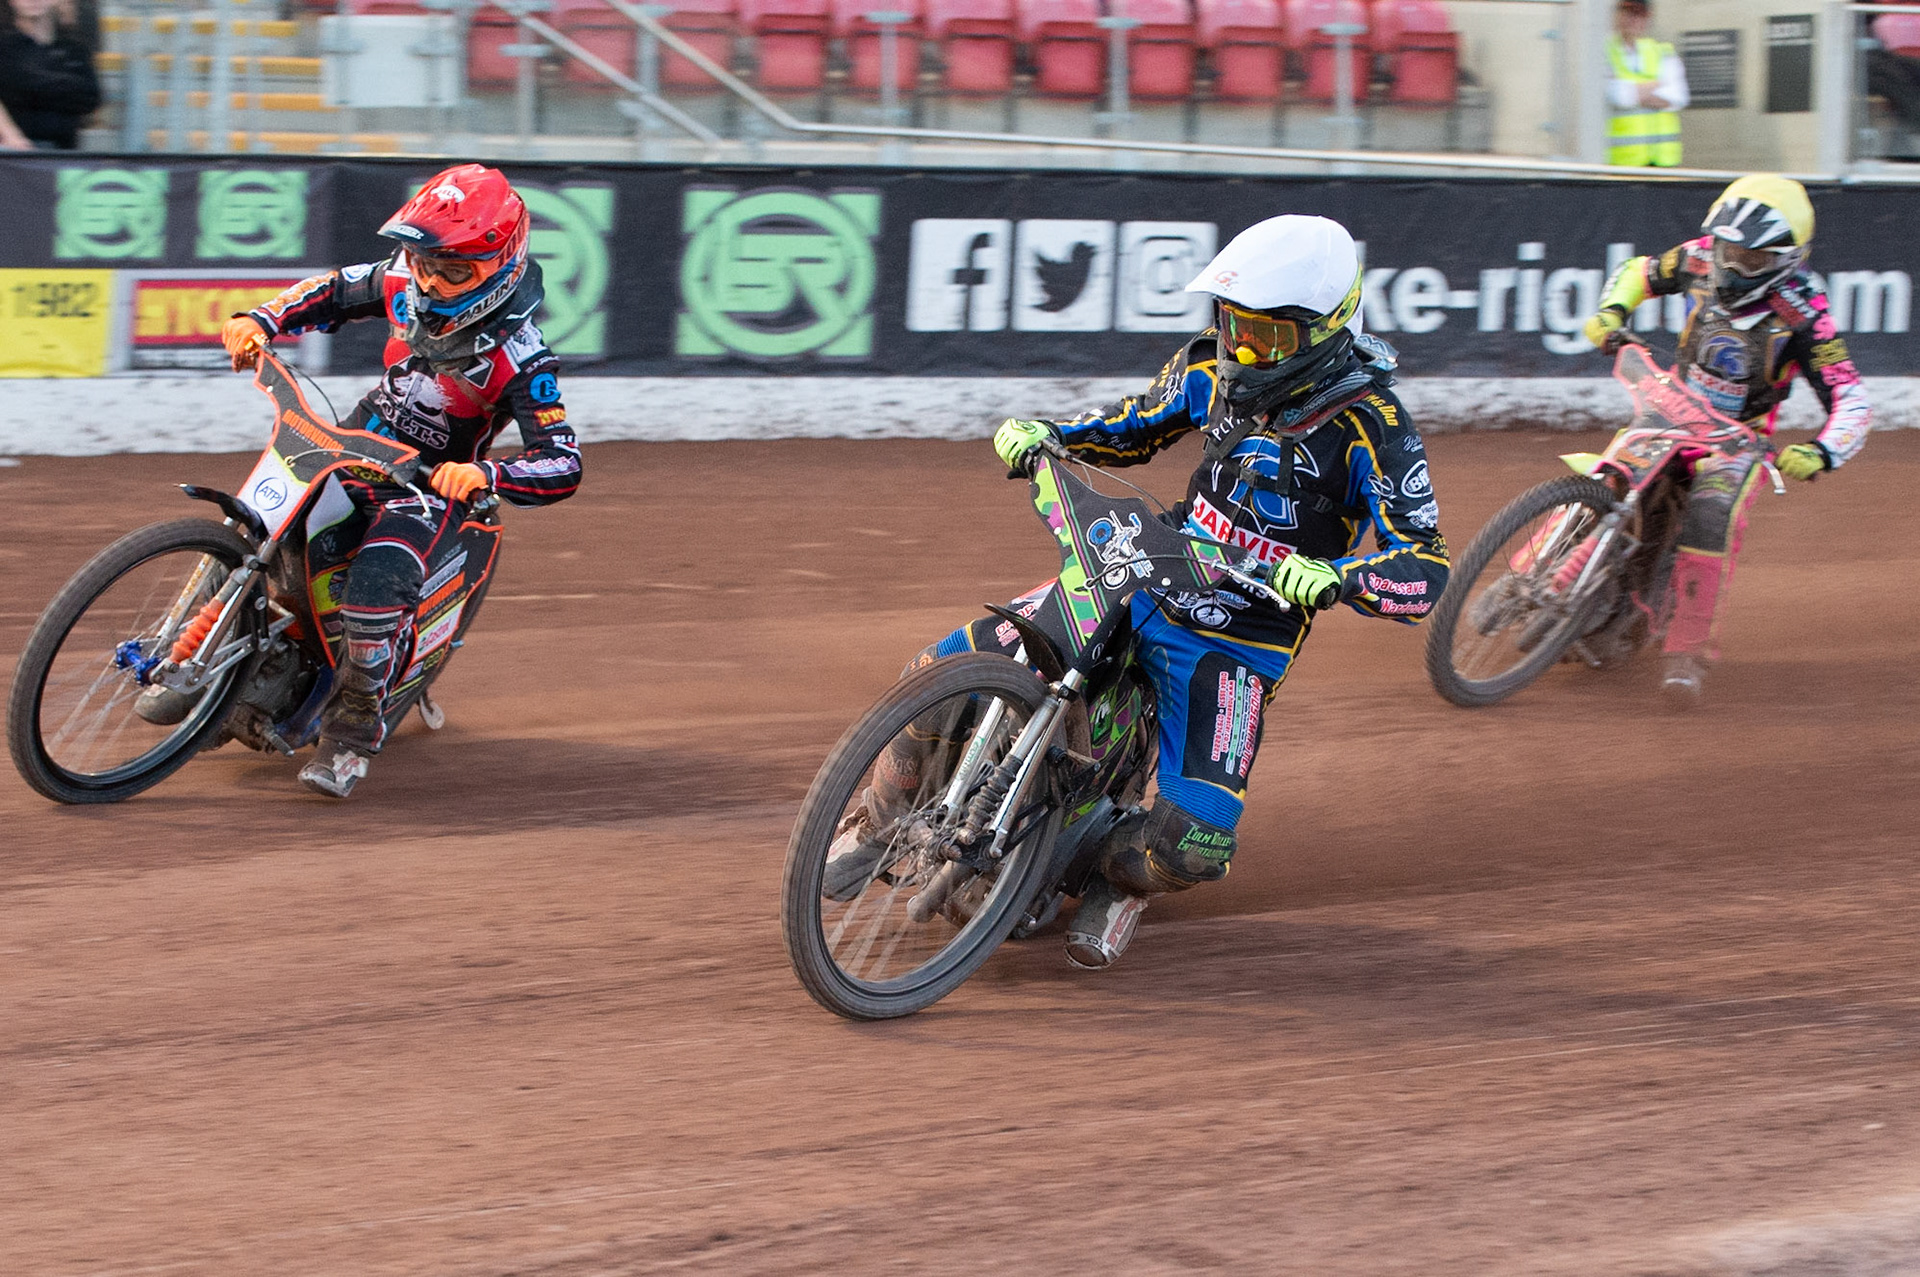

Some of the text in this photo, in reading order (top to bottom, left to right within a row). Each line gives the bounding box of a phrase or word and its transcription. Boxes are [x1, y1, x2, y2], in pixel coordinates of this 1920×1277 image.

[281, 409, 345, 458] MOTORVATION
[257, 485, 283, 503] ATPI
[1193, 500, 1292, 567] JARVIS
[1368, 572, 1428, 596] Spacesaver
[1238, 687, 1263, 779] HOSEMASTER
